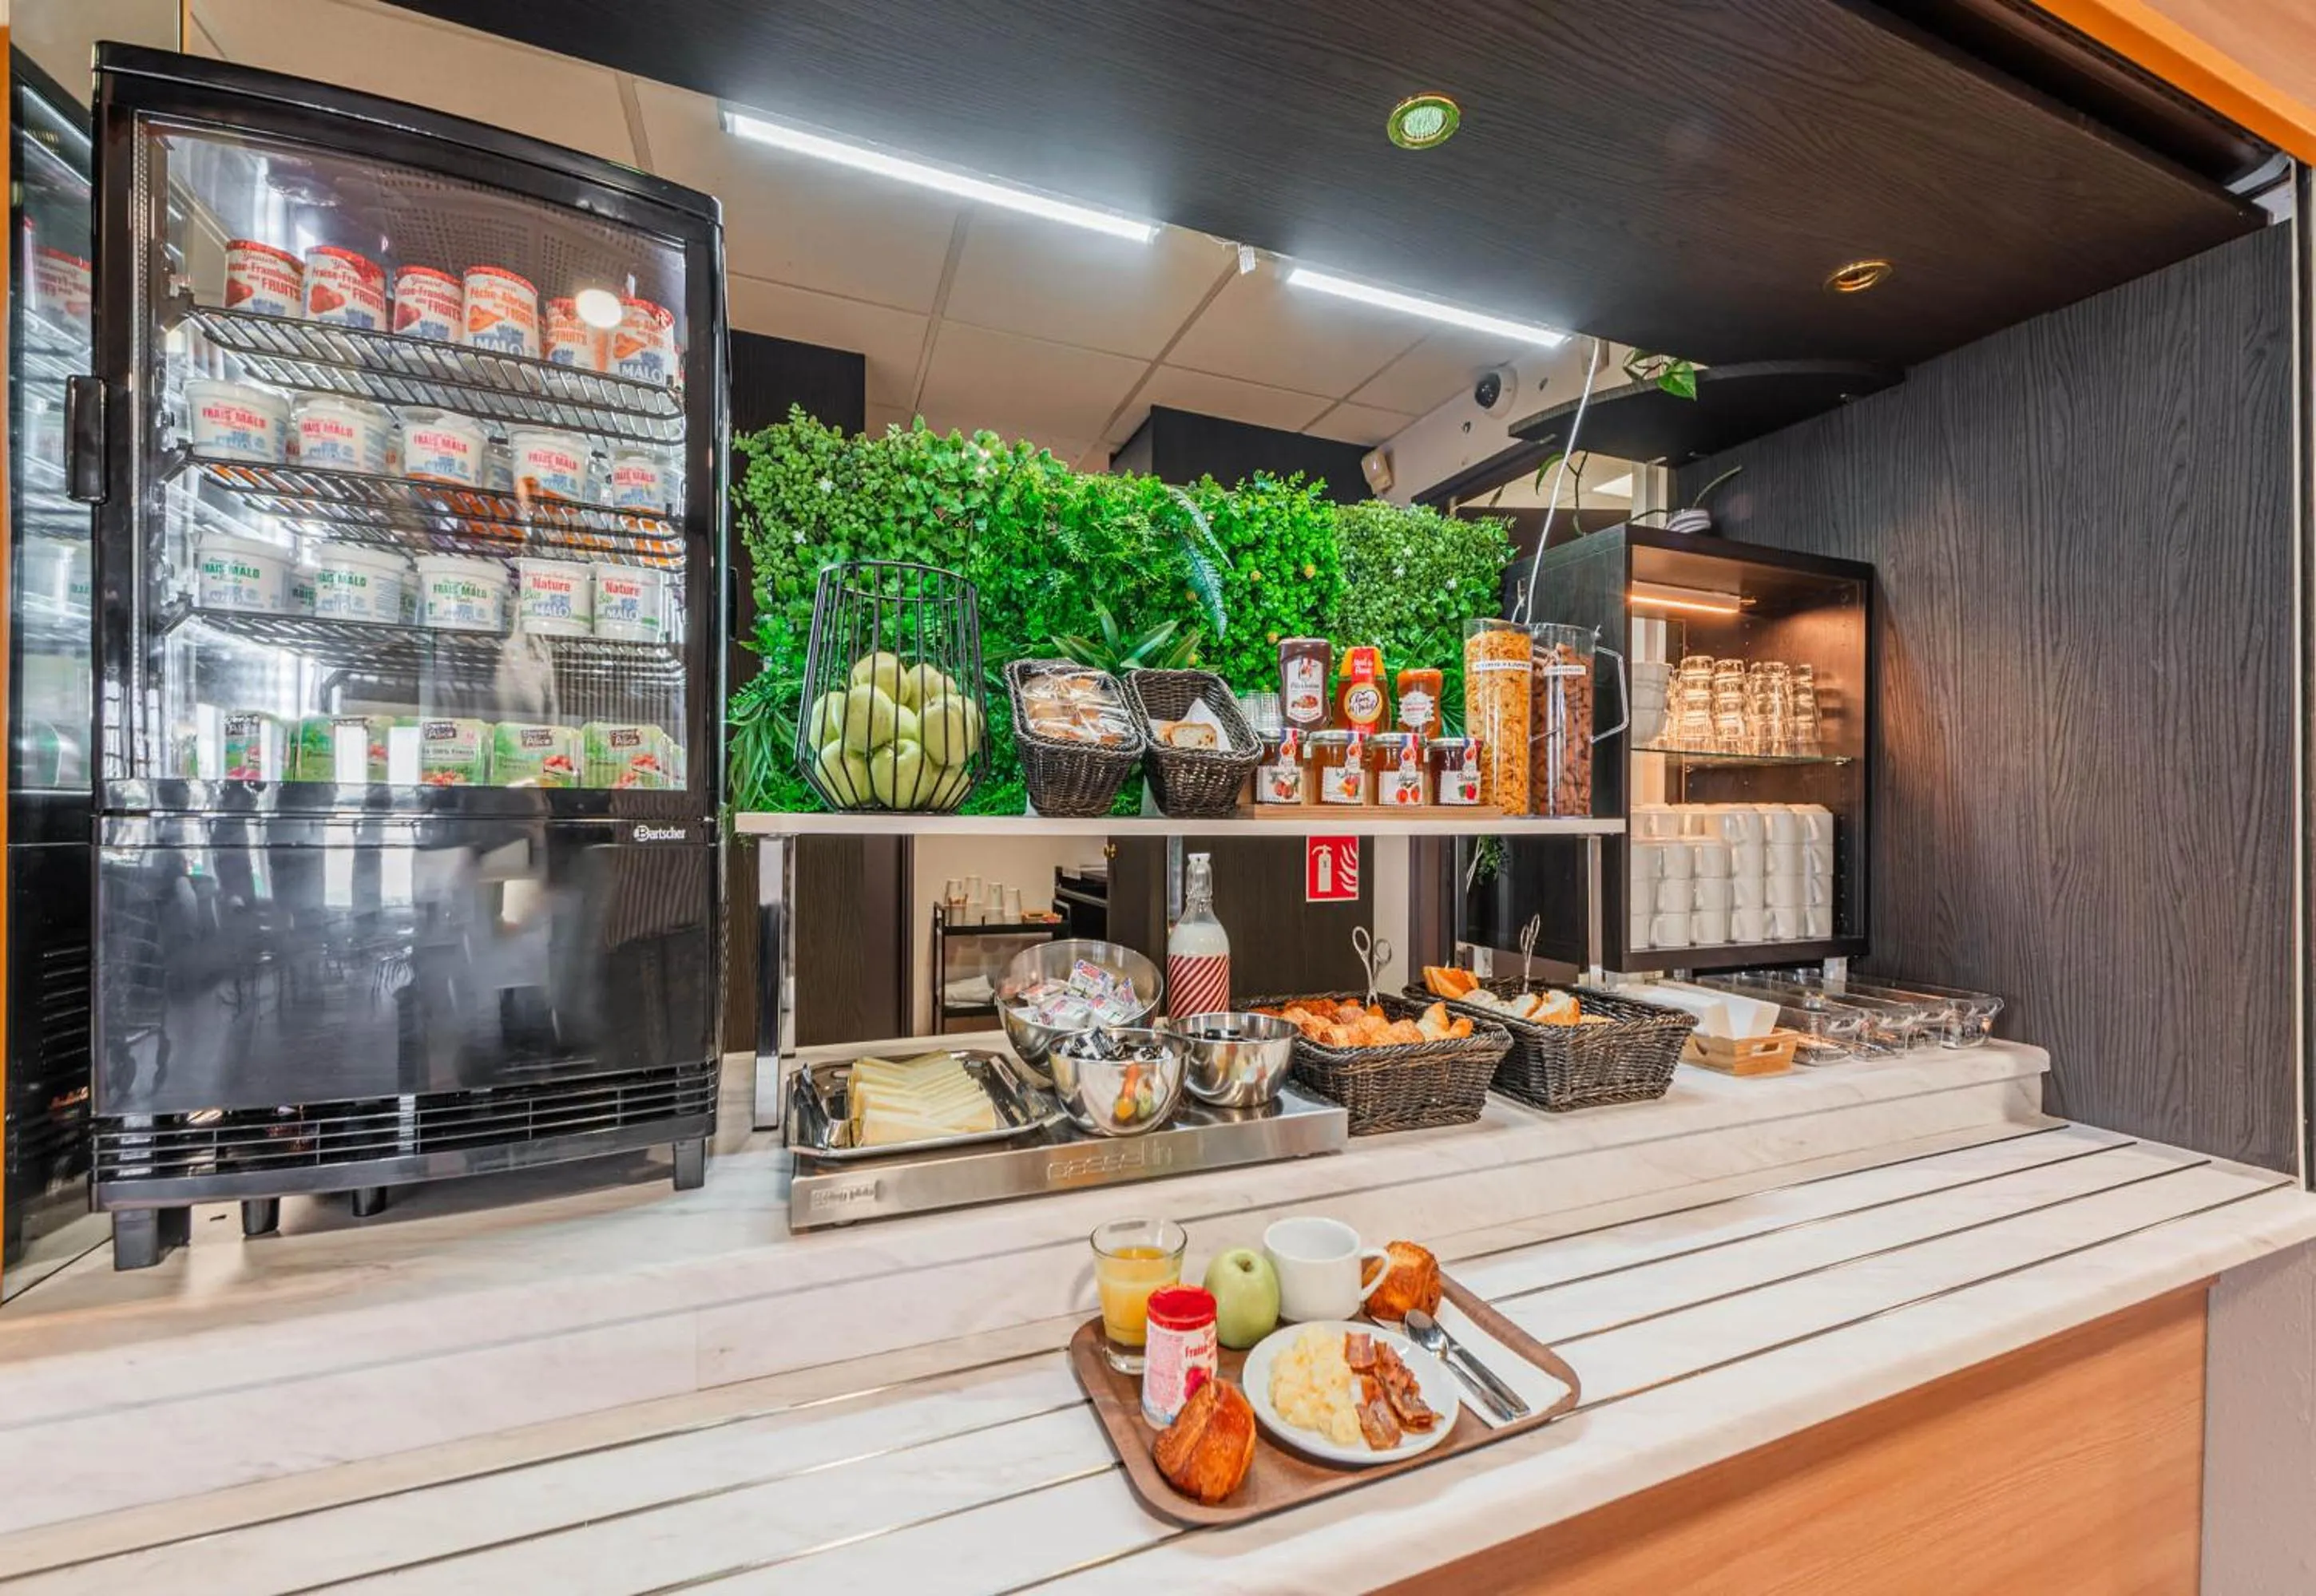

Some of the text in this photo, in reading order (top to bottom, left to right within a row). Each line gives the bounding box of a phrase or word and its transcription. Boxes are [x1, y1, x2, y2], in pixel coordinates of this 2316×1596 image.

[621, 362, 665, 385] MALO
[532, 576, 570, 592] Nature
[605, 580, 641, 597] Nature
[532, 603, 573, 620] MALO
[605, 606, 640, 622] MALO
[633, 825, 686, 842] Bartscher
